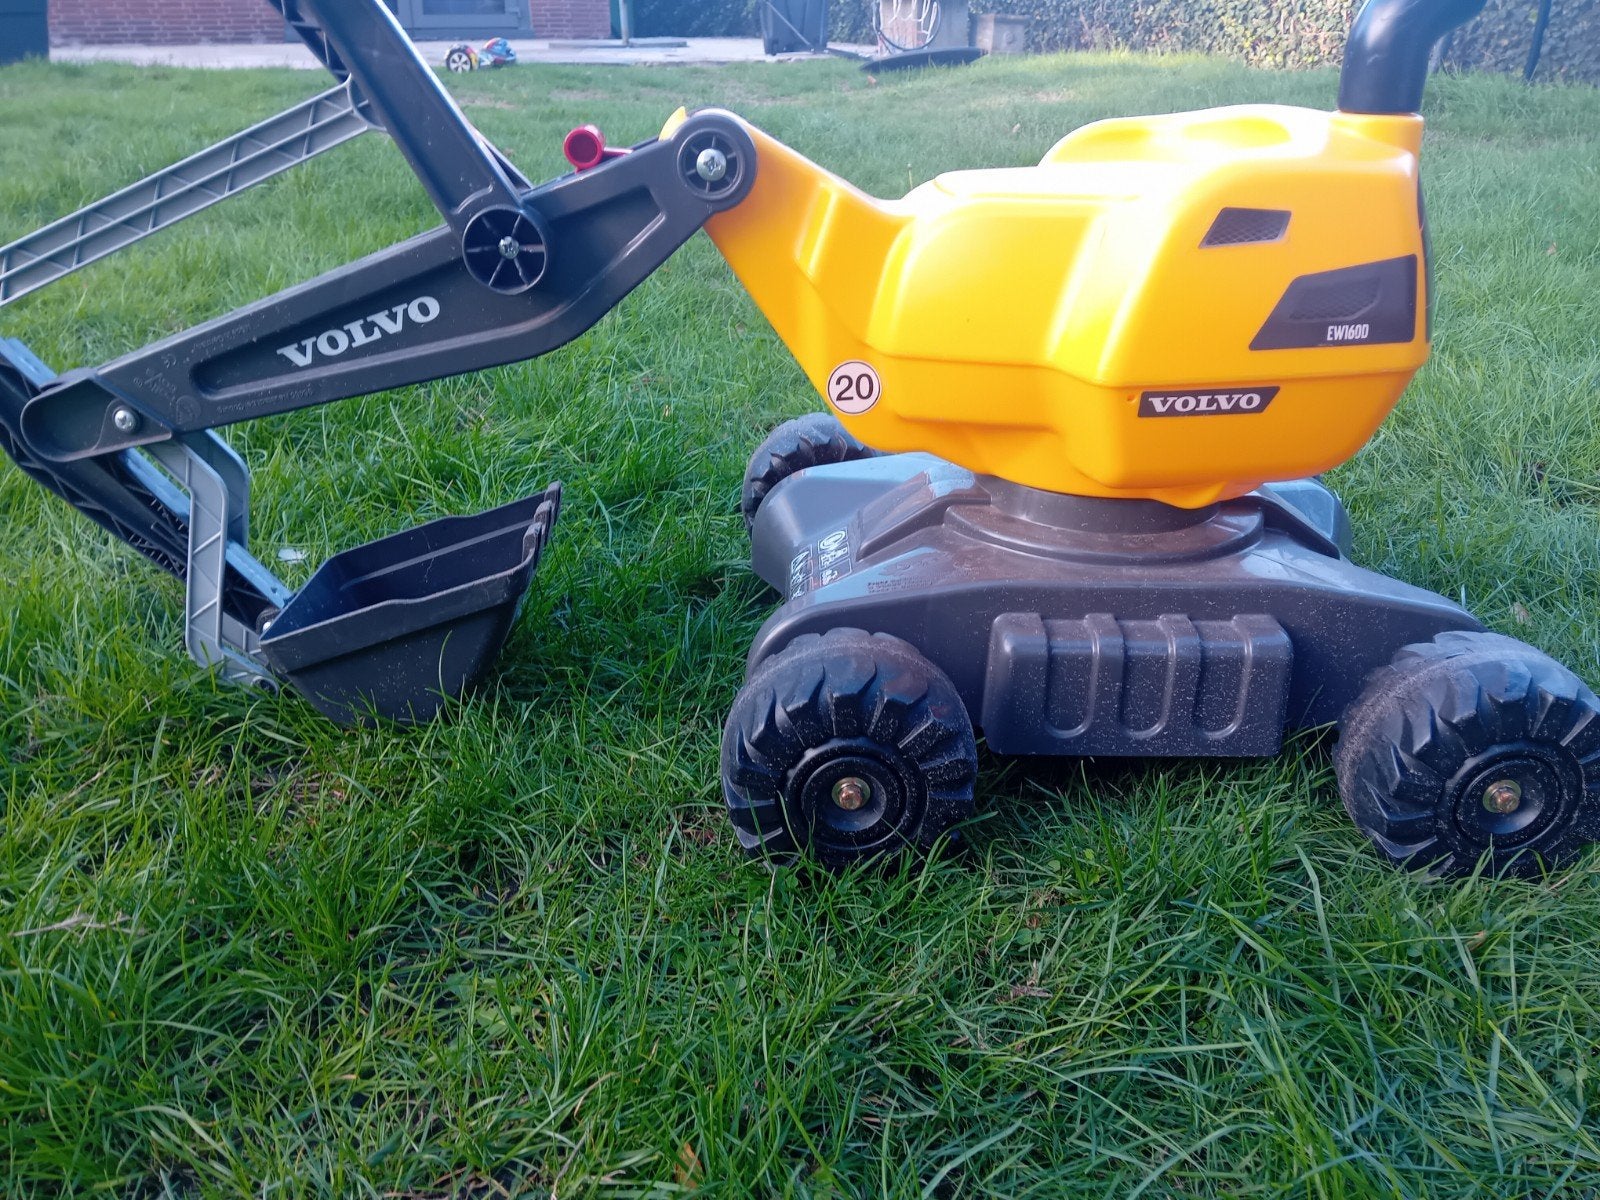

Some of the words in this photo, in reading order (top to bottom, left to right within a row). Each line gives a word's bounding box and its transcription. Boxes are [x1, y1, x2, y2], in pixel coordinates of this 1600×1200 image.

[276, 296, 440, 367] VOLVO
[1326, 323, 1370, 341] EW160D
[835, 373, 874, 401] 20
[1149, 393, 1261, 413] VOLVO
